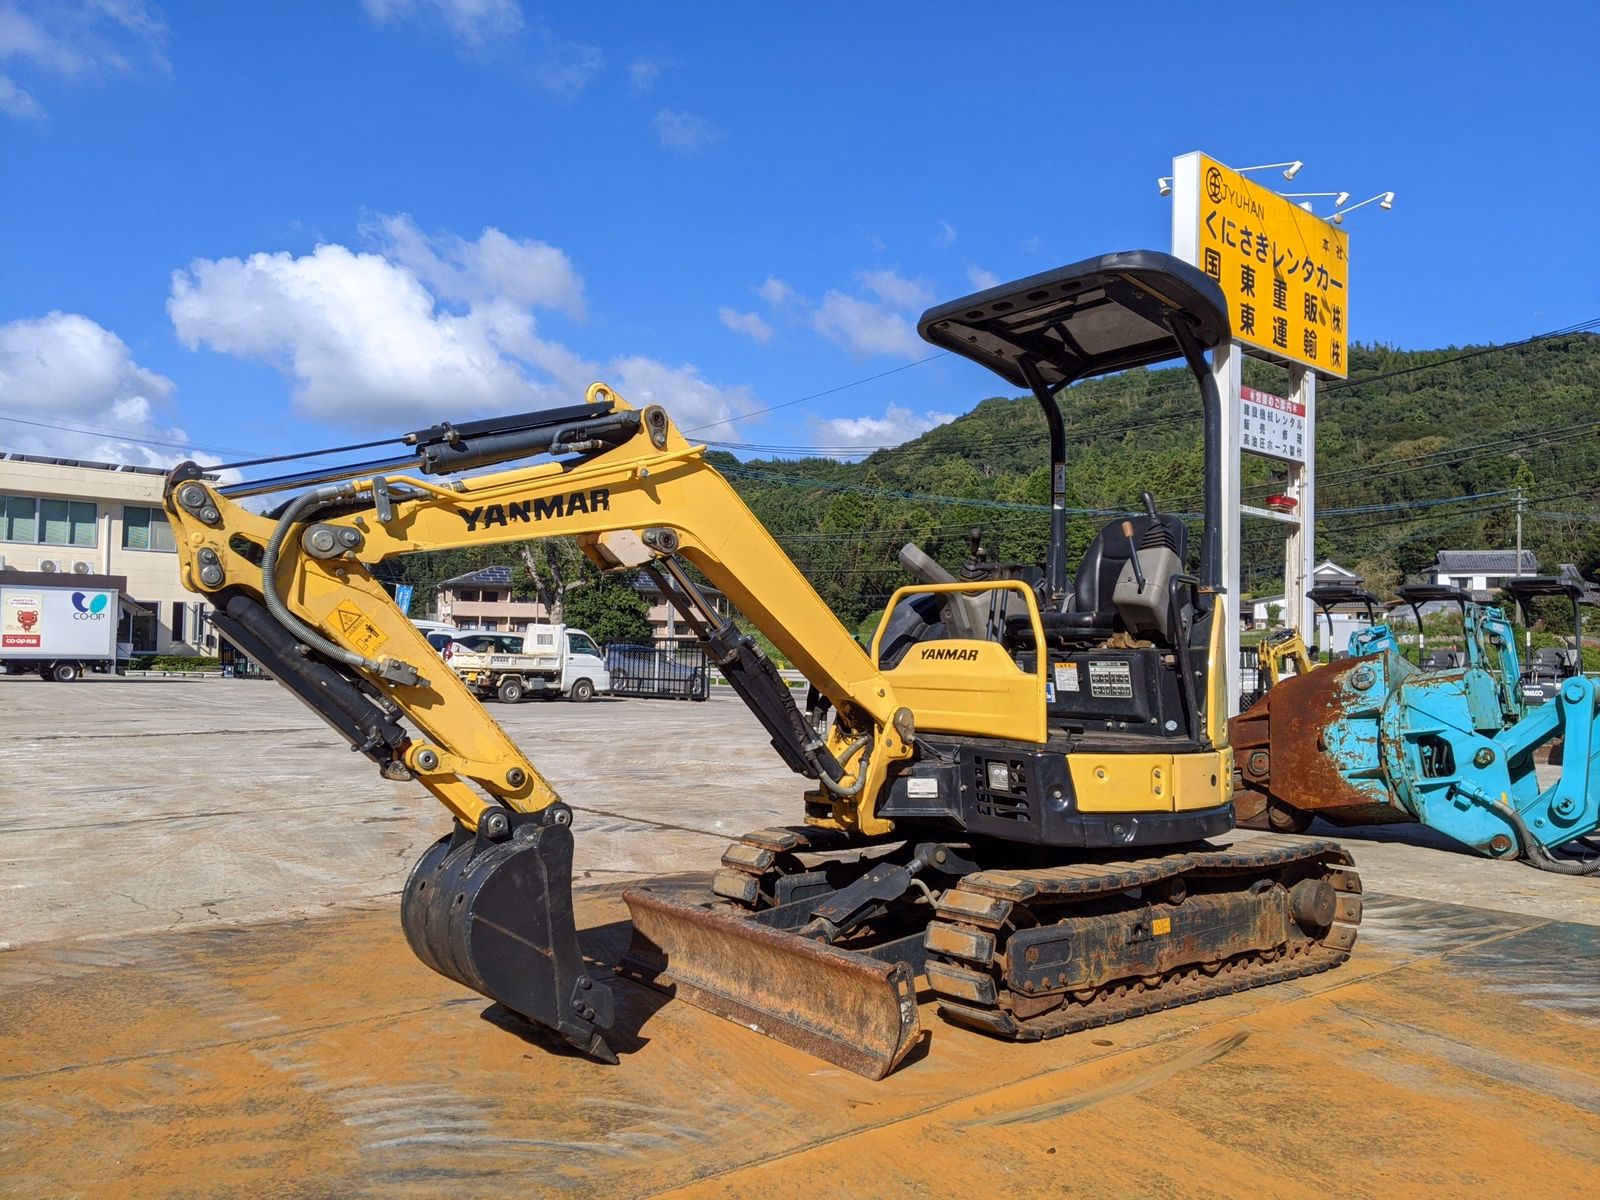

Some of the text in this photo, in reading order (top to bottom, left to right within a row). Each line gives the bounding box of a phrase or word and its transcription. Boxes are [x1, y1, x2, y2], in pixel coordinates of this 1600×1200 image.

[1220, 183, 1265, 221] JYUHAN
[1205, 210, 1343, 291] くにさきレンタカー
[1321, 237, 1344, 260] 本社
[1240, 302, 1343, 368] 東運輸(株)
[1244, 403, 1302, 430] 建設機械レンタル
[457, 488, 611, 531] YANMAR
[920, 648, 979, 661] YANMAR
